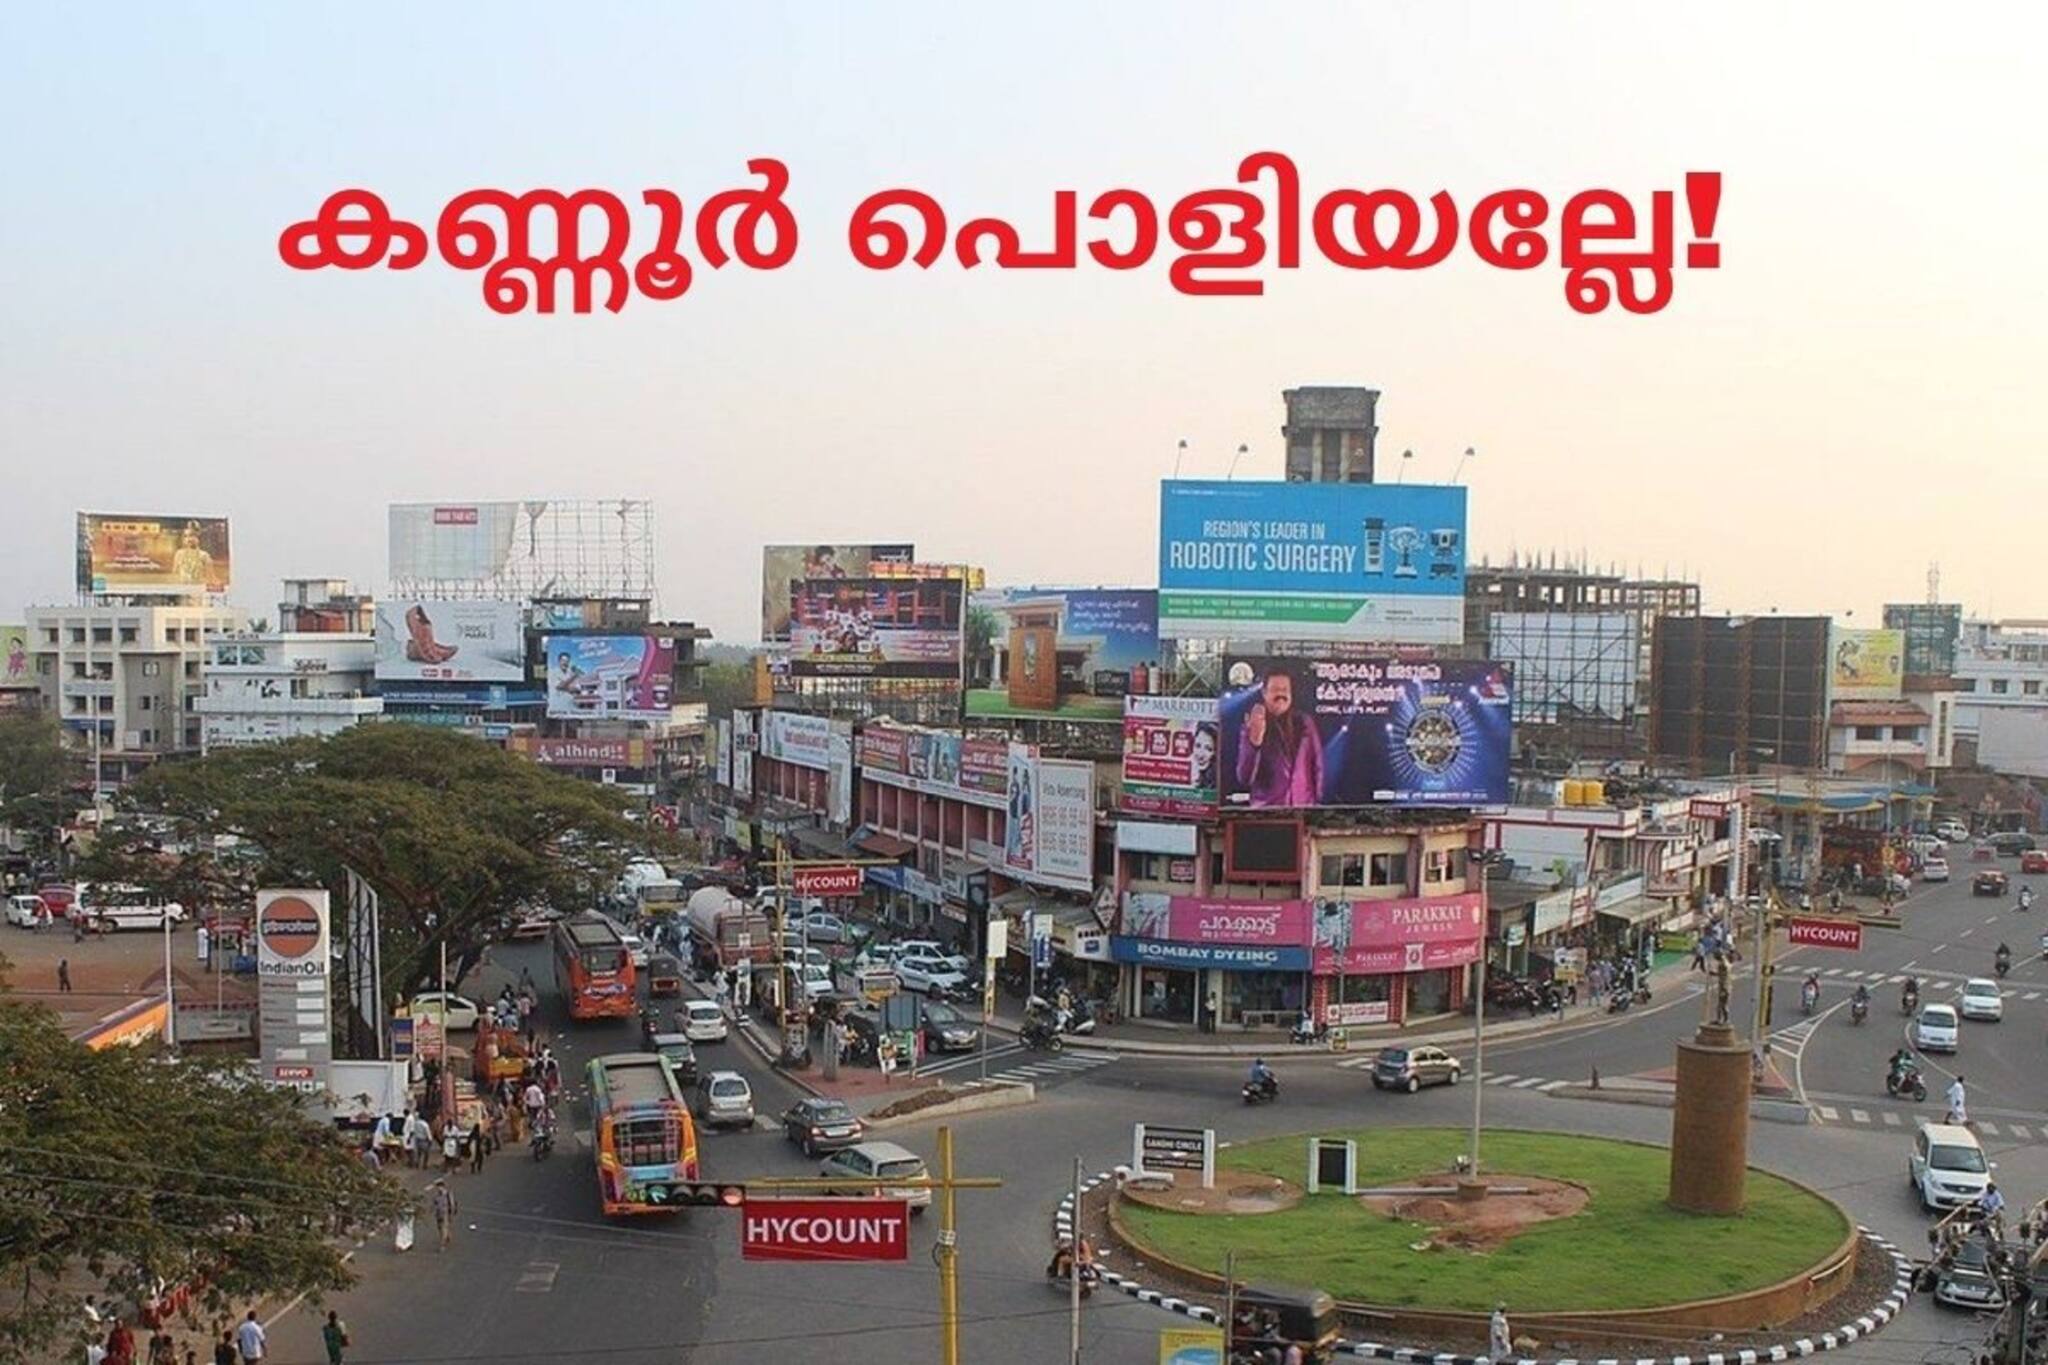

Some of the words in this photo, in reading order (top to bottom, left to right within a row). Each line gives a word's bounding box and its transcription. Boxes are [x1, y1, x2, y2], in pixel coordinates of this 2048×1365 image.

[1203, 520, 1260, 538] REGION'S
[1263, 520, 1309, 540] LEADER
[1311, 522, 1326, 540] IN
[1170, 541, 1257, 570] ROBOTIC
[1264, 544, 1357, 573] SURGERY
[555, 744, 609, 758] alhind
[796, 876, 857, 888] HYCOUNT
[1392, 905, 1462, 924] PARAKKAT
[1792, 925, 1858, 943] HYCOUNT
[1137, 943, 1210, 959] BOMBAY
[1213, 951, 1278, 962] DYEING
[260, 961, 325, 975] IndianOil
[1175, 1140, 1202, 1151] CIRCLE
[747, 1217, 902, 1244] HYCOUNT
